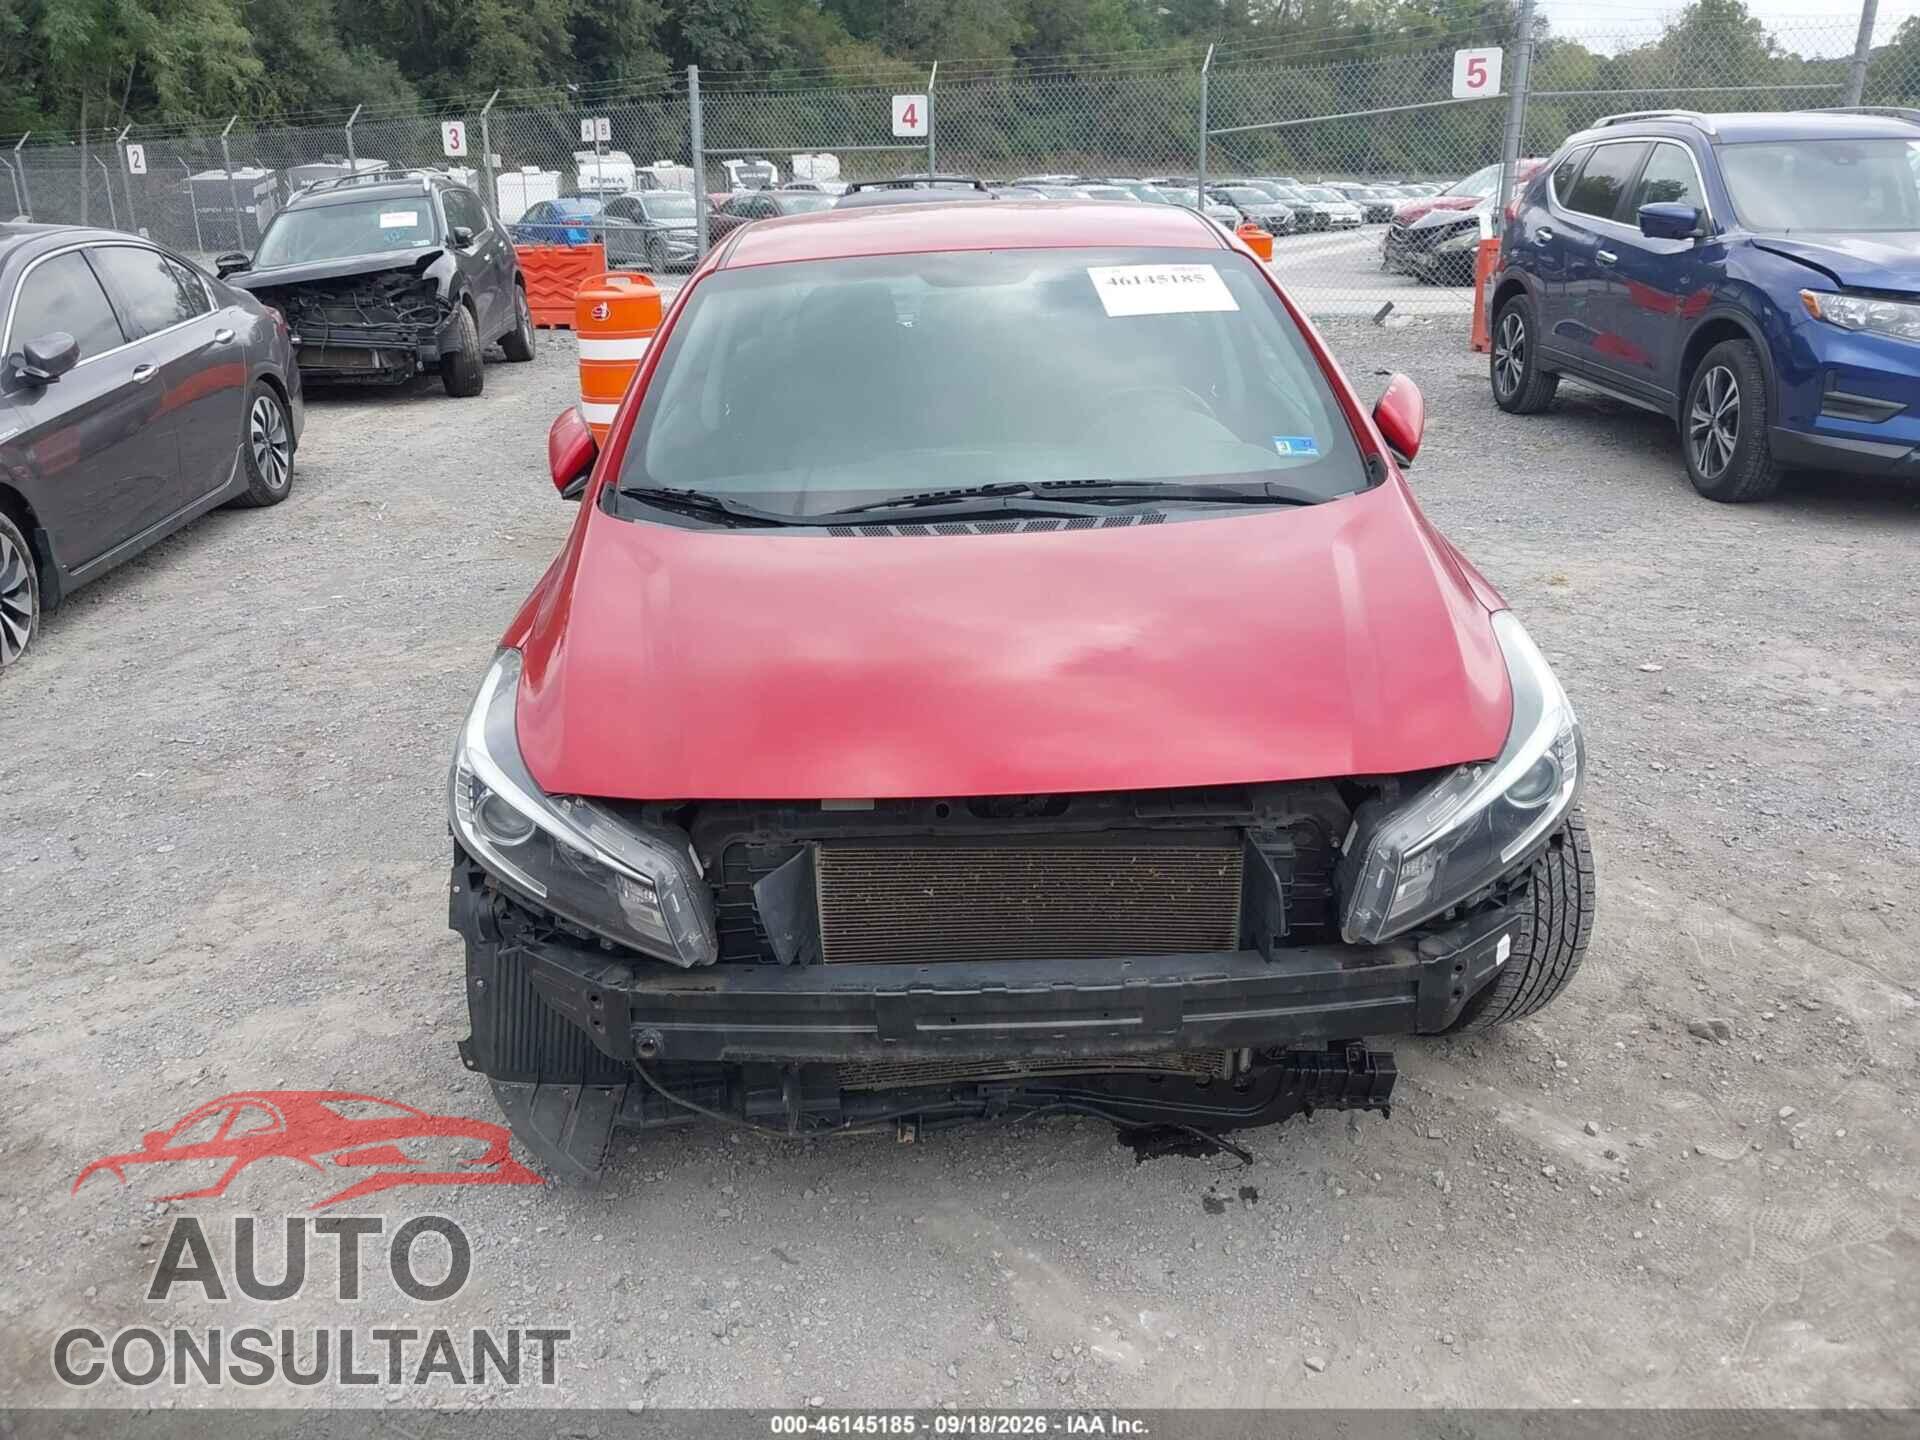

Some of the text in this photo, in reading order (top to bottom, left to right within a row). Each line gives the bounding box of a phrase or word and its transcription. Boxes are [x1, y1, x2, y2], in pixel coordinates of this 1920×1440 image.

[1467, 58, 1487, 88] 5
[901, 103, 918, 129] 4
[449, 128, 460, 150] 3
[132, 150, 142, 169] 2
[1106, 274, 1206, 286] 46145185
